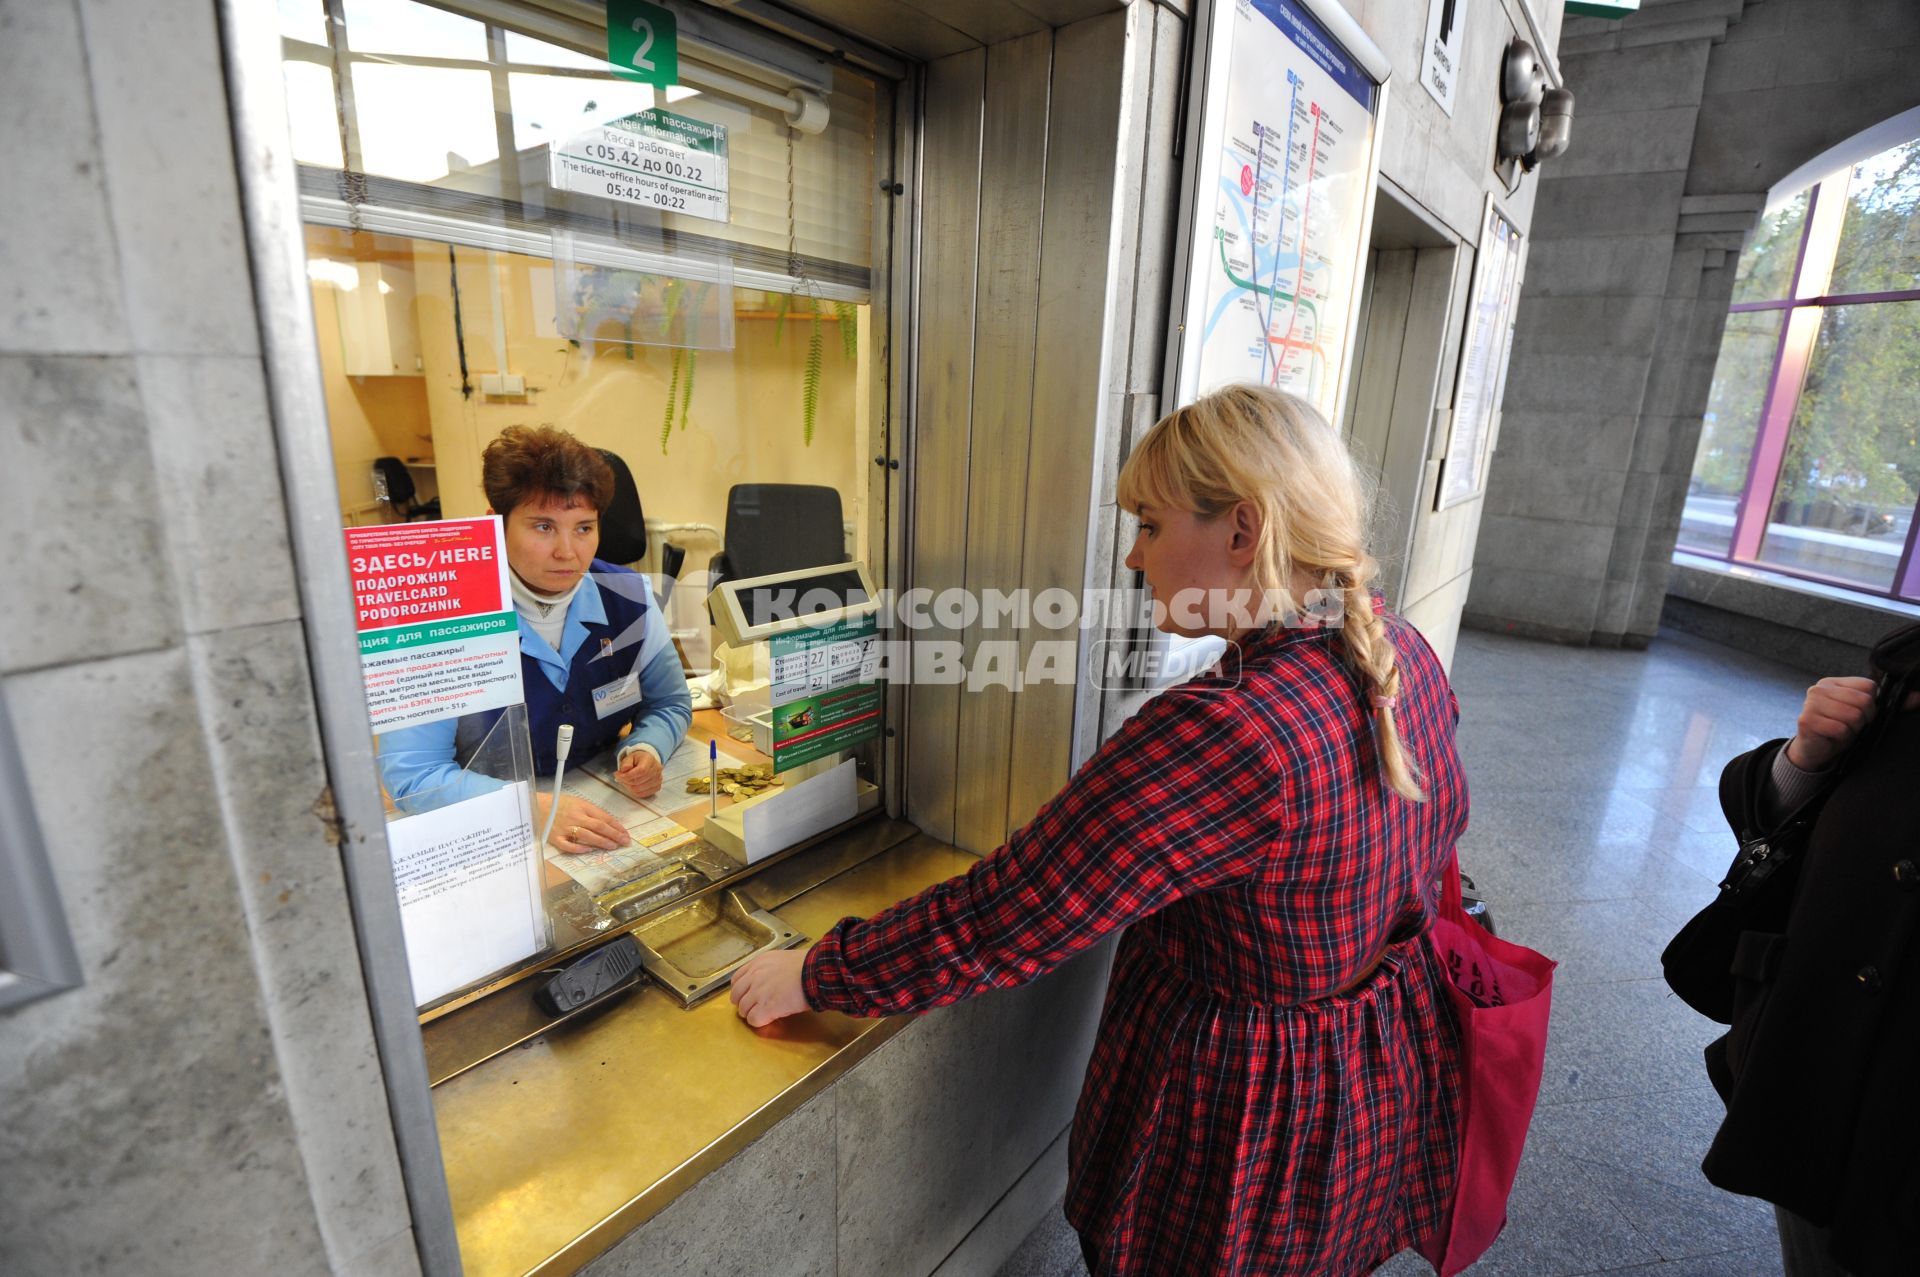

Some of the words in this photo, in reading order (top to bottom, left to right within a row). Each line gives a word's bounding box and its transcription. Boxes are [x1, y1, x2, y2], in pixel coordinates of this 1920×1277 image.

[632, 17, 655, 72] 2
[644, 124, 698, 146] information
[662, 114, 725, 141] пассажиров
[603, 130, 635, 147] Касса
[638, 140, 686, 160] работает
[597, 144, 640, 167] 05.42
[643, 160, 662, 172] до
[665, 161, 703, 182] 00.22
[562, 159, 579, 172] The
[580, 164, 634, 184] ticket-office
[635, 178, 659, 190] hours
[659, 182, 669, 191] of
[669, 185, 707, 200] operation
[606, 183, 641, 201] 05:42
[653, 193, 686, 210] 00:22
[352, 546, 493, 574] ЗДЕСЬ/HERE
[356, 570, 458, 592] ПОДОРОЖНИК
[357, 585, 448, 607] TRAVELCARD
[360, 598, 462, 622] PODOROZHNIK
[396, 631, 422, 644] для
[429, 618, 507, 638] пассажиров
[775, 631, 820, 645] Информация
[822, 626, 836, 635] для
[827, 630, 859, 642] information
[410, 645, 465, 661] пассажиры!
[863, 639, 875, 652] 27
[406, 660, 444, 674] продажа
[444, 657, 462, 667] всех
[463, 650, 508, 663] нельготных
[775, 655, 808, 666] Стоимость
[811, 651, 824, 665] 27
[864, 663, 873, 673] 27
[390, 684, 416, 693] метро
[472, 670, 492, 679] виды
[396, 671, 433, 685] (единый
[473, 658, 504, 669] единый
[812, 676, 823, 688] 27
[399, 690, 430, 701] билеты
[431, 682, 472, 695] наземного
[474, 672, 517, 687] транспорта)
[775, 690, 786, 698] Cost
[793, 685, 807, 693] travel
[407, 707, 444, 719] носителя
[451, 702, 460, 710] 51
